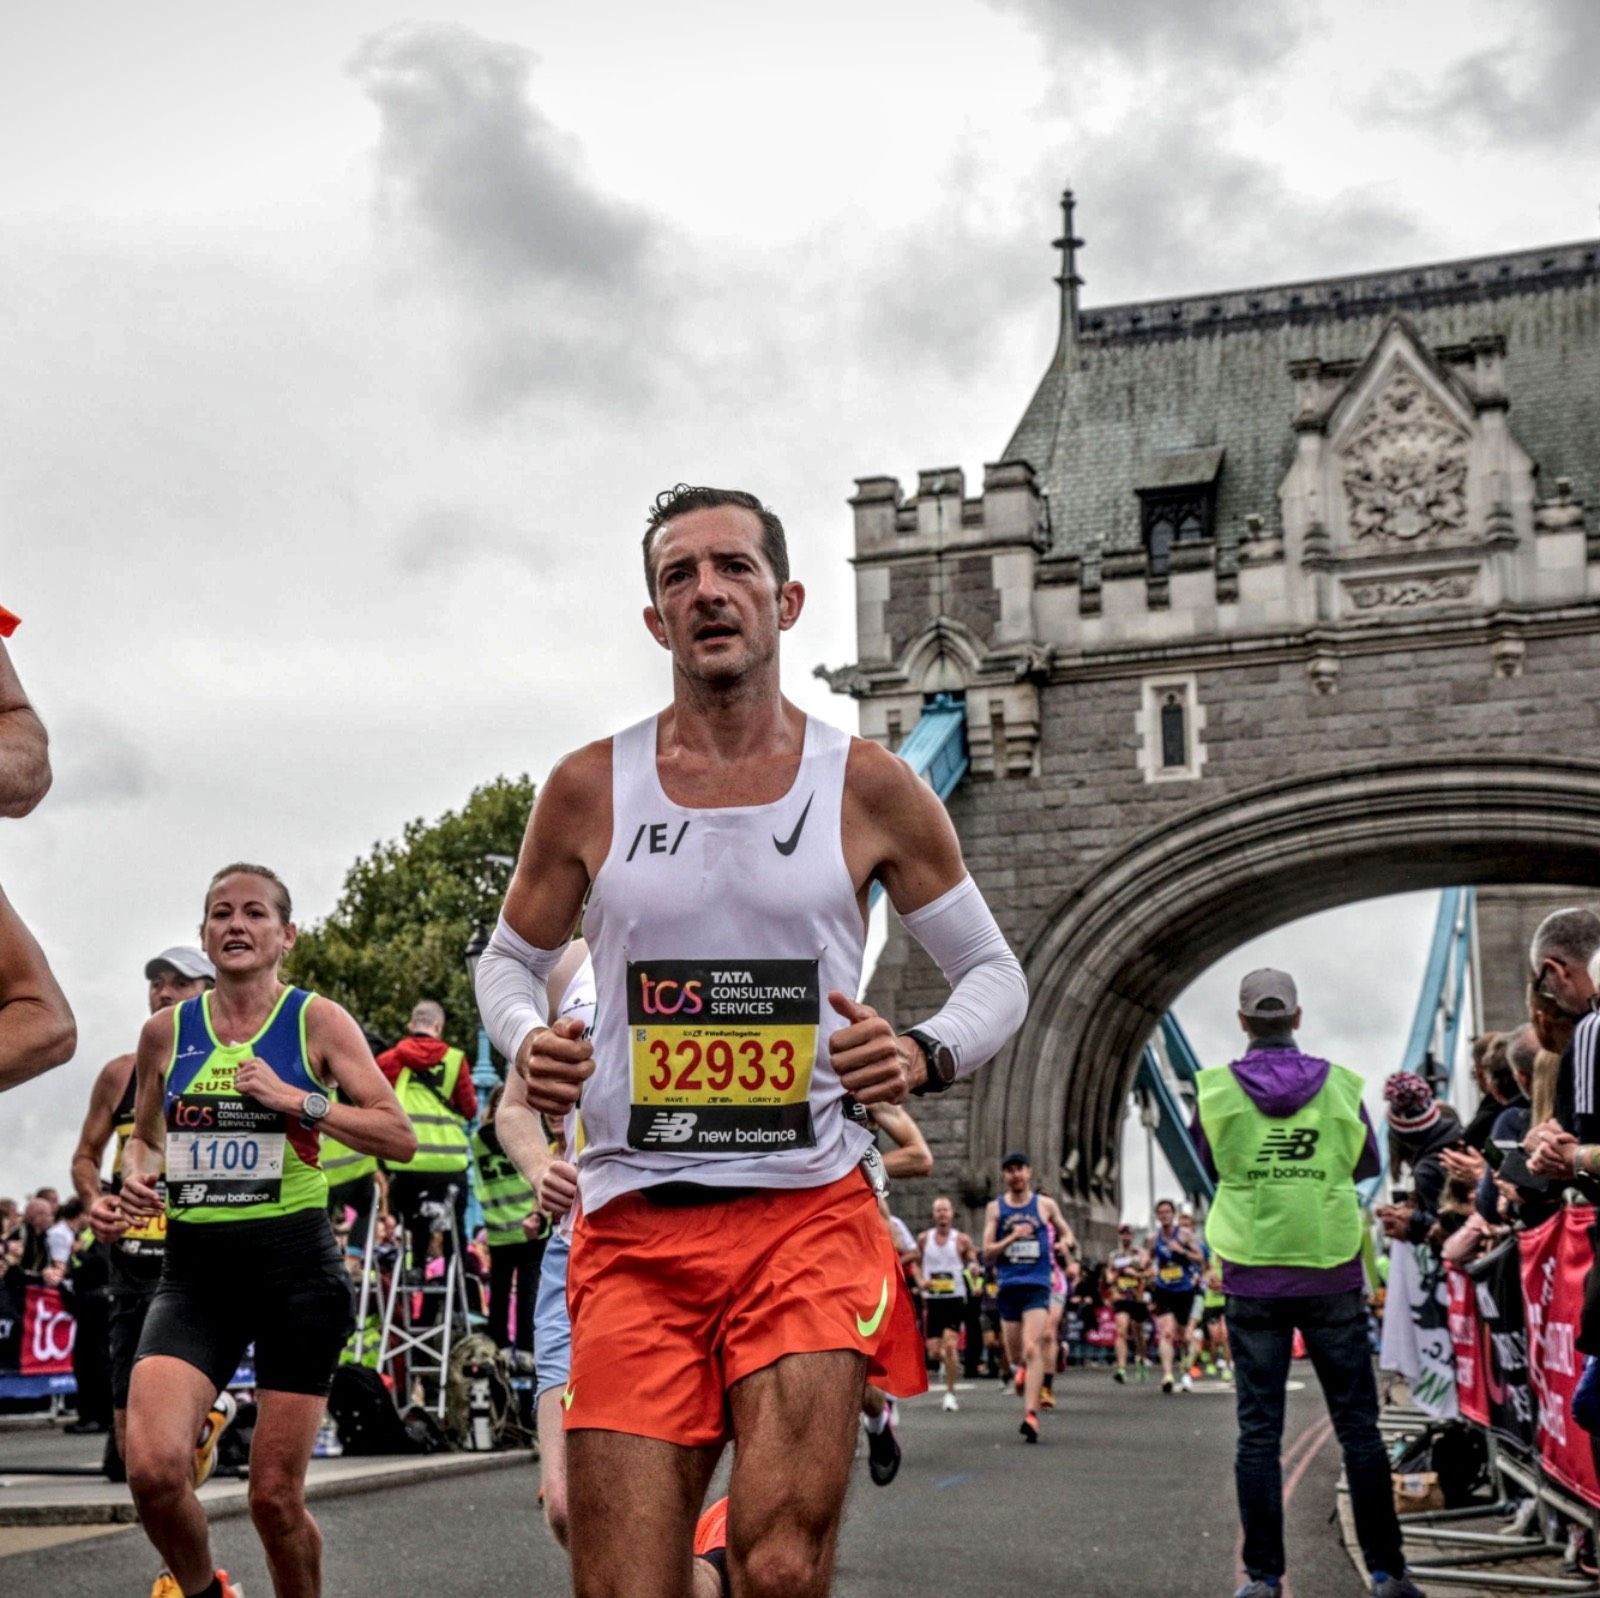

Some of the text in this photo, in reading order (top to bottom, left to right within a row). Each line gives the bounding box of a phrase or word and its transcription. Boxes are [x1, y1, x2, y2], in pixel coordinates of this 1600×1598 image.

[711, 972, 753, 984] TATA
[640, 972, 703, 1014] tcs
[711, 987, 807, 1000] CONSULTANCY
[711, 1002, 774, 1015] SERVICES
[212, 1067, 238, 1076] WEST
[649, 1039, 796, 1092] 32933
[193, 1080, 233, 1094] SUS
[217, 1101, 243, 1110] TATA
[175, 1100, 214, 1127] tcs
[217, 1110, 278, 1121] CONSULTANCY
[217, 1119, 257, 1128] SERVICES
[699, 1128, 796, 1143] new balance
[190, 1139, 259, 1171] 1100
[206, 1191, 270, 1203] new balance
